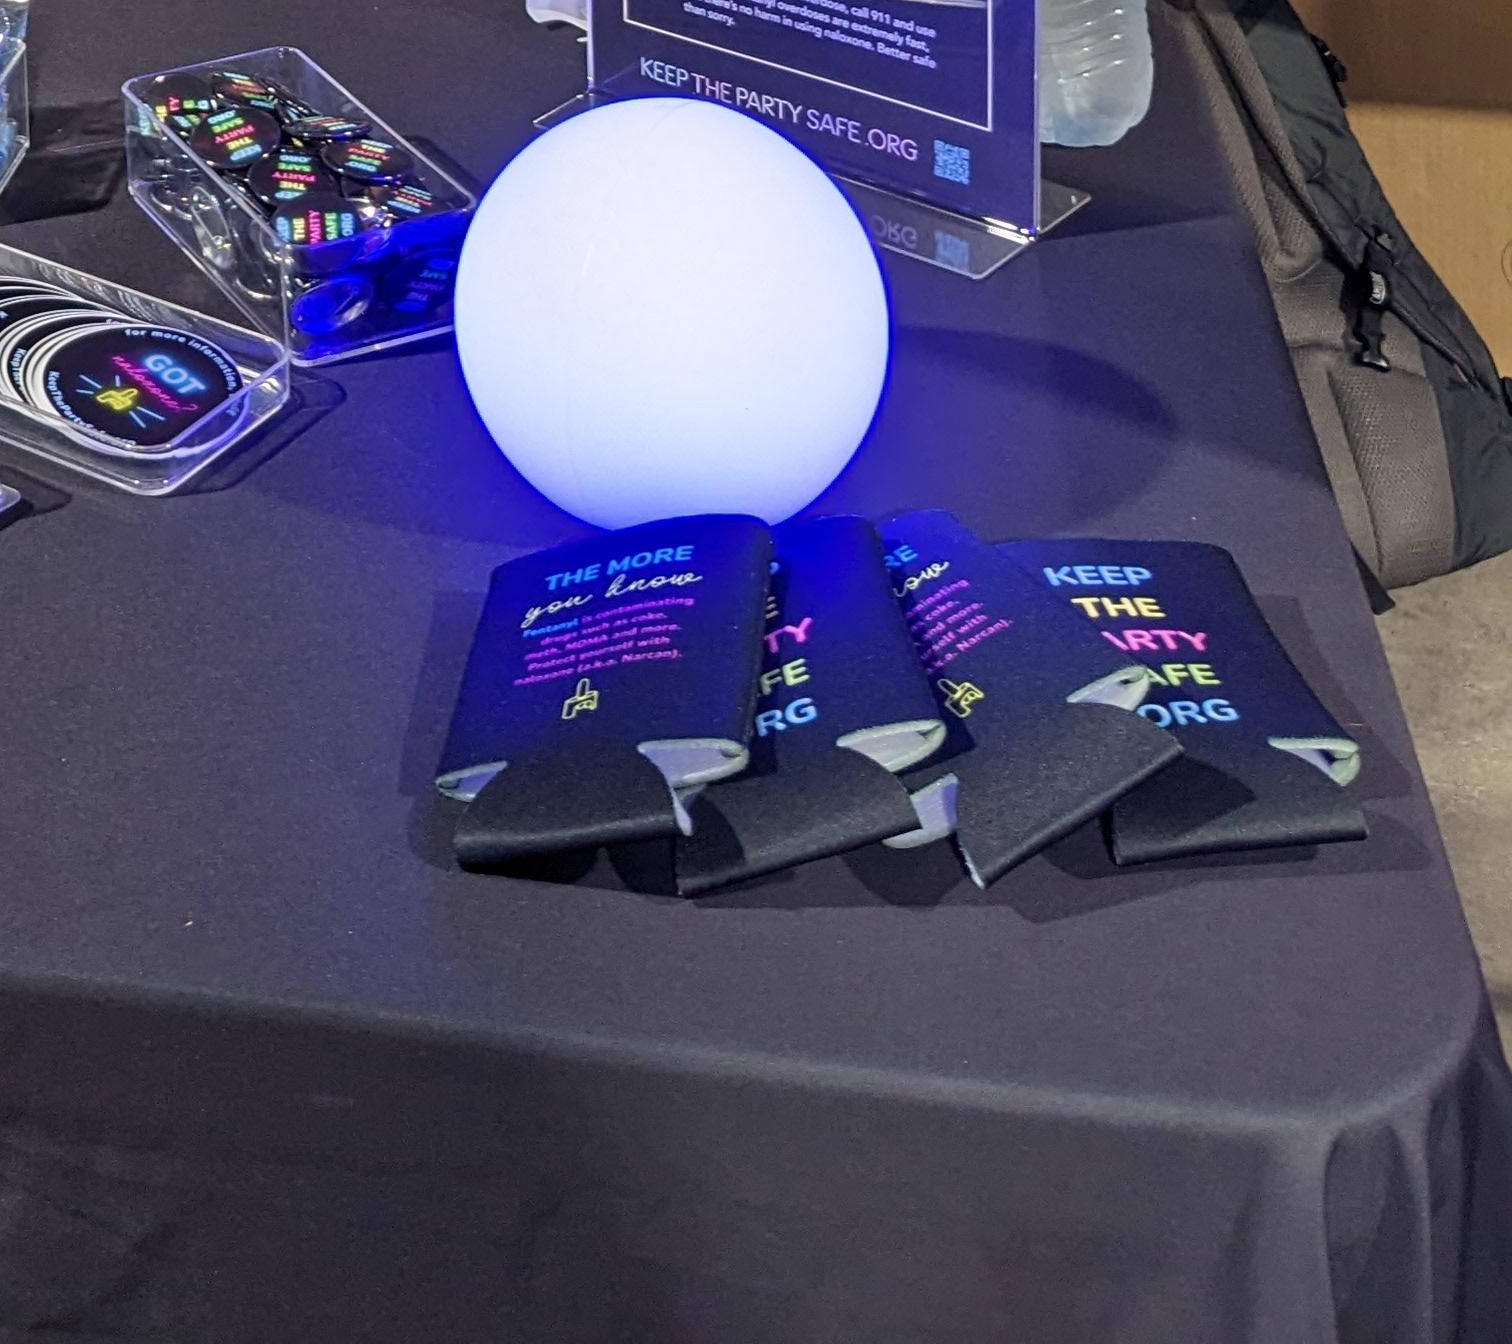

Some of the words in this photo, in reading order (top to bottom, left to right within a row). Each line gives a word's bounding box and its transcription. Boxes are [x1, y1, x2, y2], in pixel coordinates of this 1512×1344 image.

[640, 56, 689, 88] KEEP
[690, 72, 732, 104] THE
[736, 86, 803, 123] PARTY
[806, 108, 861, 144] SAFE
[215, 124, 255, 144] PARTY
[226, 136, 253, 150] THE
[271, 171, 316, 183] PARTY
[292, 217, 306, 242] THE
[124, 328, 148, 337] for
[151, 331, 187, 343] more
[142, 353, 208, 395] GOT
[545, 563, 602, 591] THE
[606, 545, 695, 575] MORE
[1043, 565, 1153, 586] KEEP
[520, 594, 594, 629] you
[604, 572, 704, 598] know
[1070, 596, 1168, 618] THE
[522, 617, 579, 638] Fentanyl
[580, 615, 594, 624] is
[595, 598, 695, 620] contaminating
[540, 631, 579, 646] drugs
[580, 622, 611, 635] such
[612, 619, 629, 628] as
[611, 626, 638, 639] and
